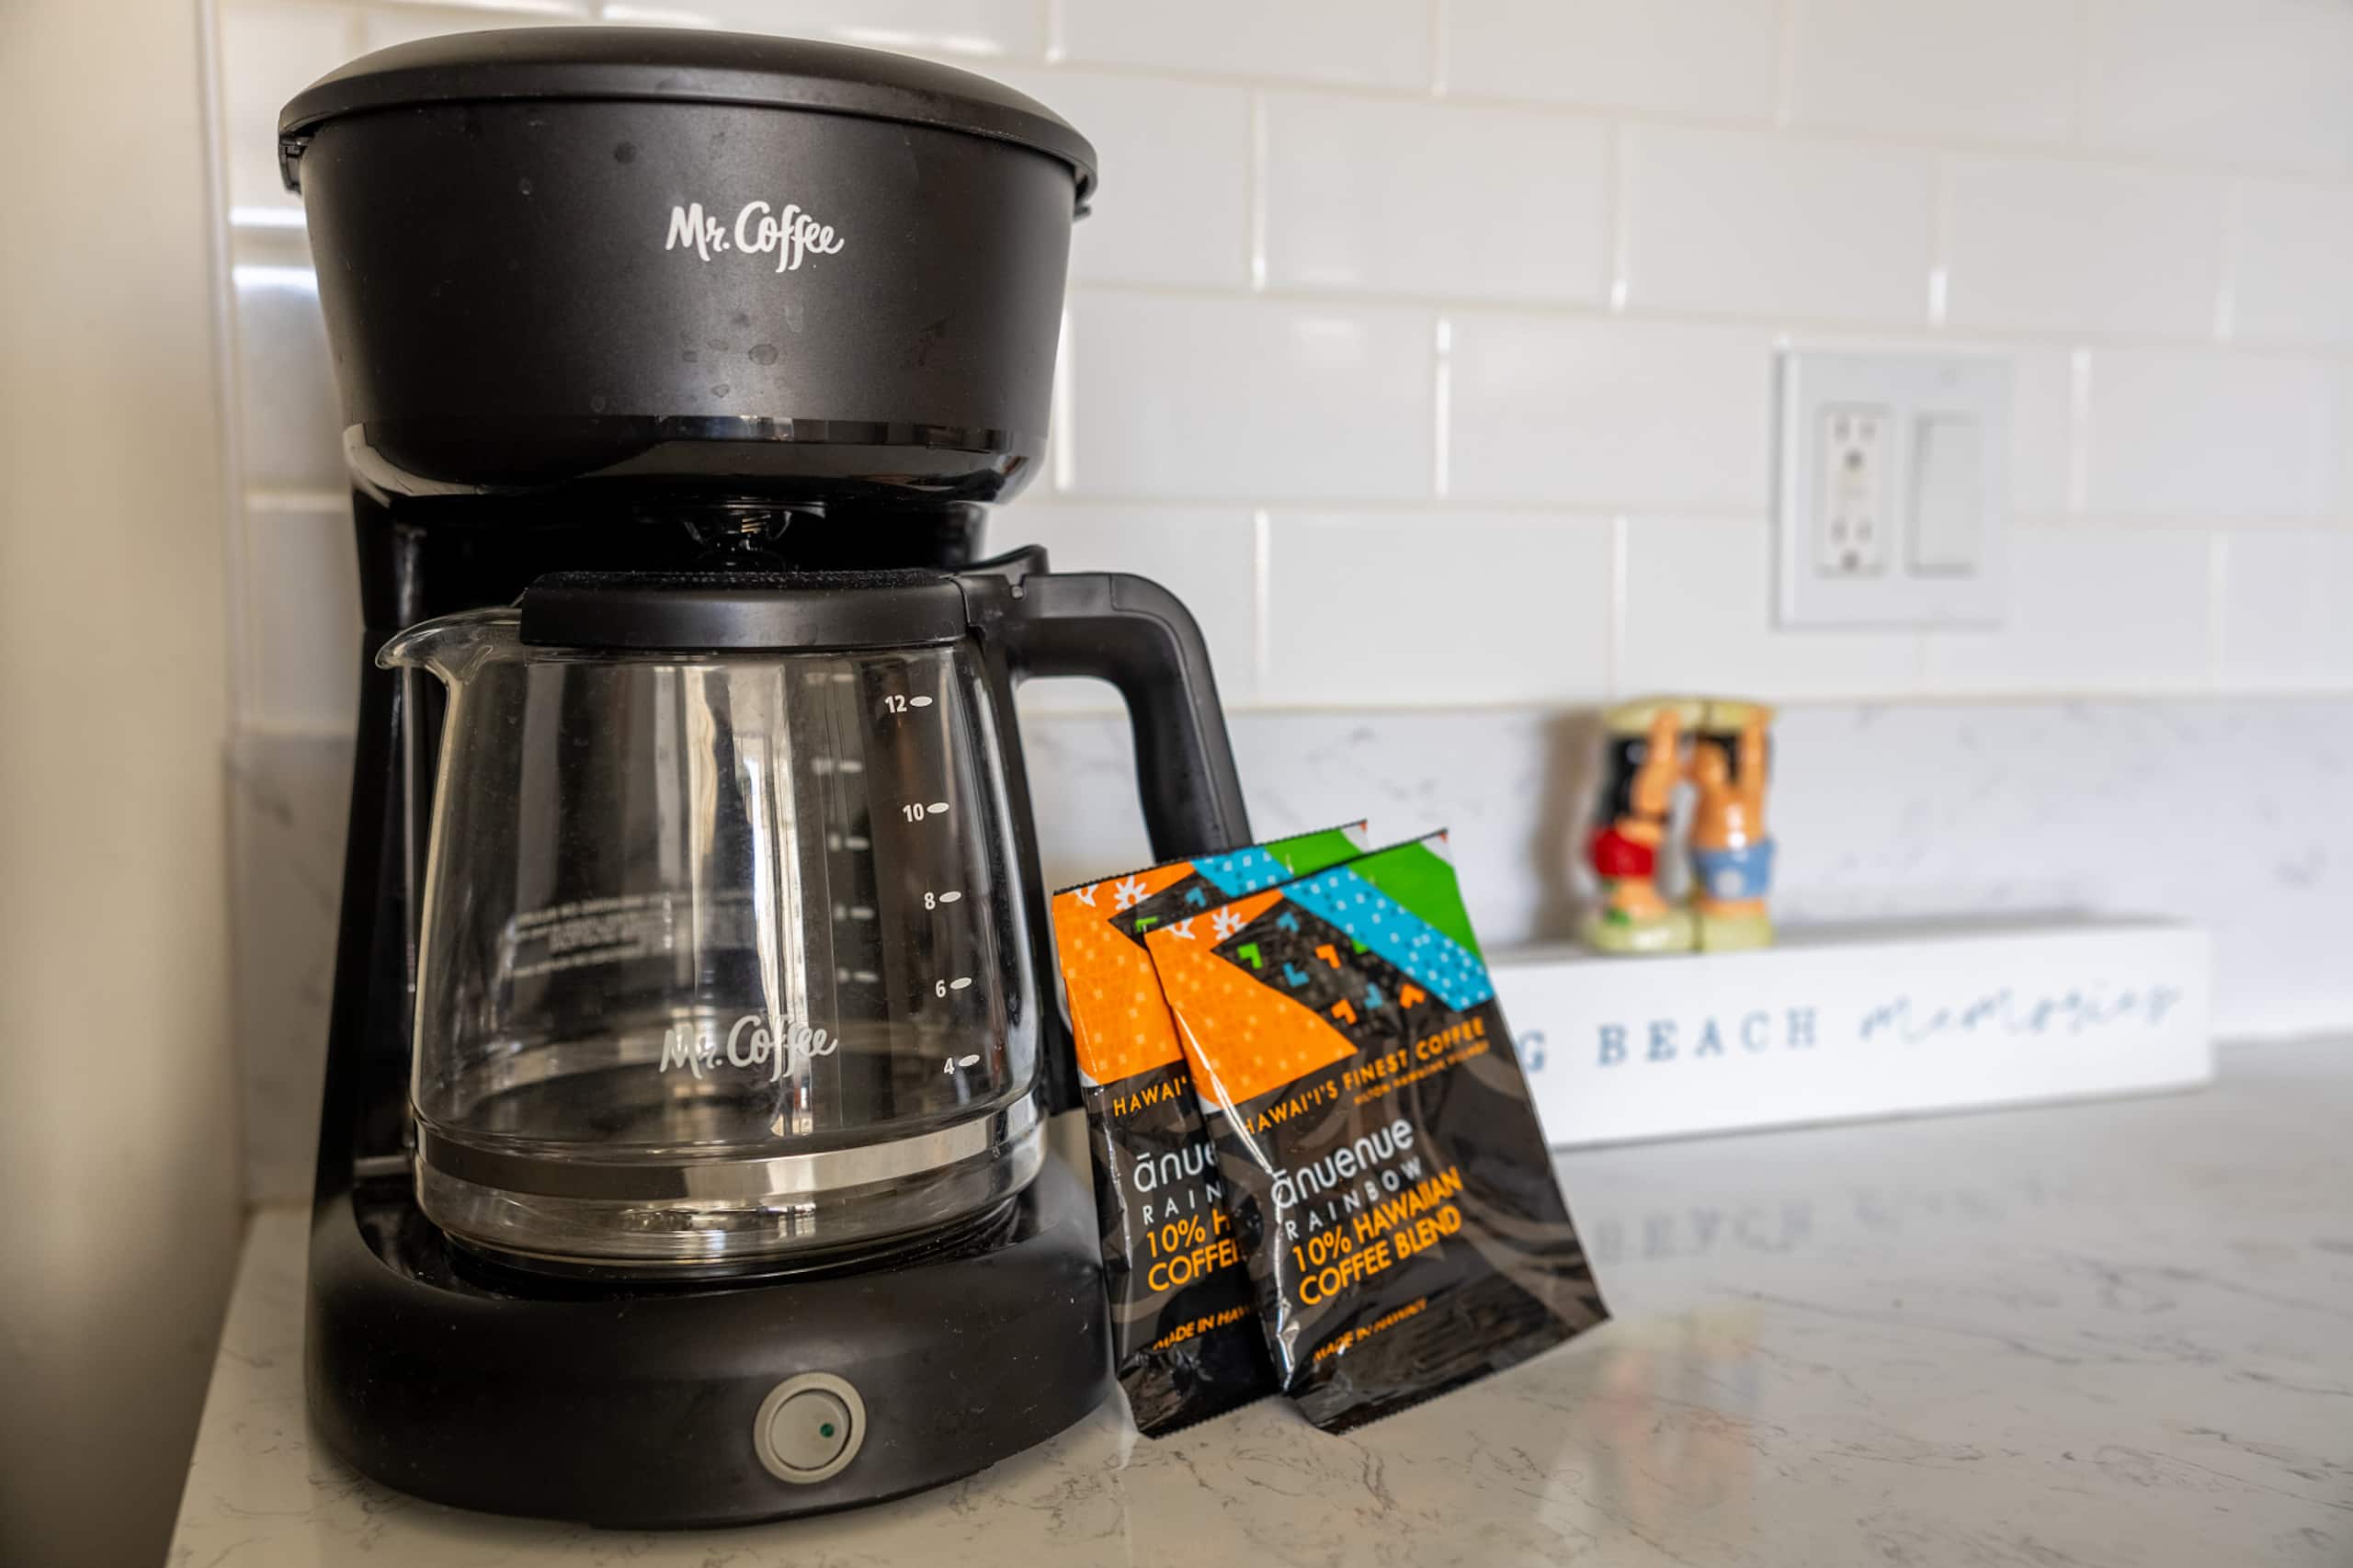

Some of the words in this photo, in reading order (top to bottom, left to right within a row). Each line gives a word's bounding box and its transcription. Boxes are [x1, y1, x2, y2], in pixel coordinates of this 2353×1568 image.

[665, 202, 731, 262] Mr.
[734, 200, 846, 273] Coffee
[884, 694, 908, 714] 12
[902, 802, 925, 823] 10
[924, 892, 936, 911] 8
[935, 979, 947, 998] 6
[658, 1021, 723, 1080] Mr.
[726, 1014, 838, 1083] Coffee
[1342, 1048, 1409, 1092] FINEST
[1415, 1016, 1486, 1062] COFFEE
[1518, 1030, 1548, 1074] G
[1597, 1005, 1819, 1068] BEACH
[943, 1056, 955, 1075] 4
[1132, 1142, 1219, 1193] ānue
[1270, 1118, 1415, 1209] ānuenue
[1142, 1180, 1222, 1226] RAIN
[1284, 1155, 1423, 1242] RAINBOW
[1292, 1223, 1352, 1273] 10%
[1353, 1165, 1464, 1244] HAWAIIAN
[1146, 1213, 1206, 1258] 10%
[1298, 1239, 1393, 1305] COFFEE
[1392, 1204, 1462, 1260] BLEND
[1196, 1313, 1216, 1334] IN
